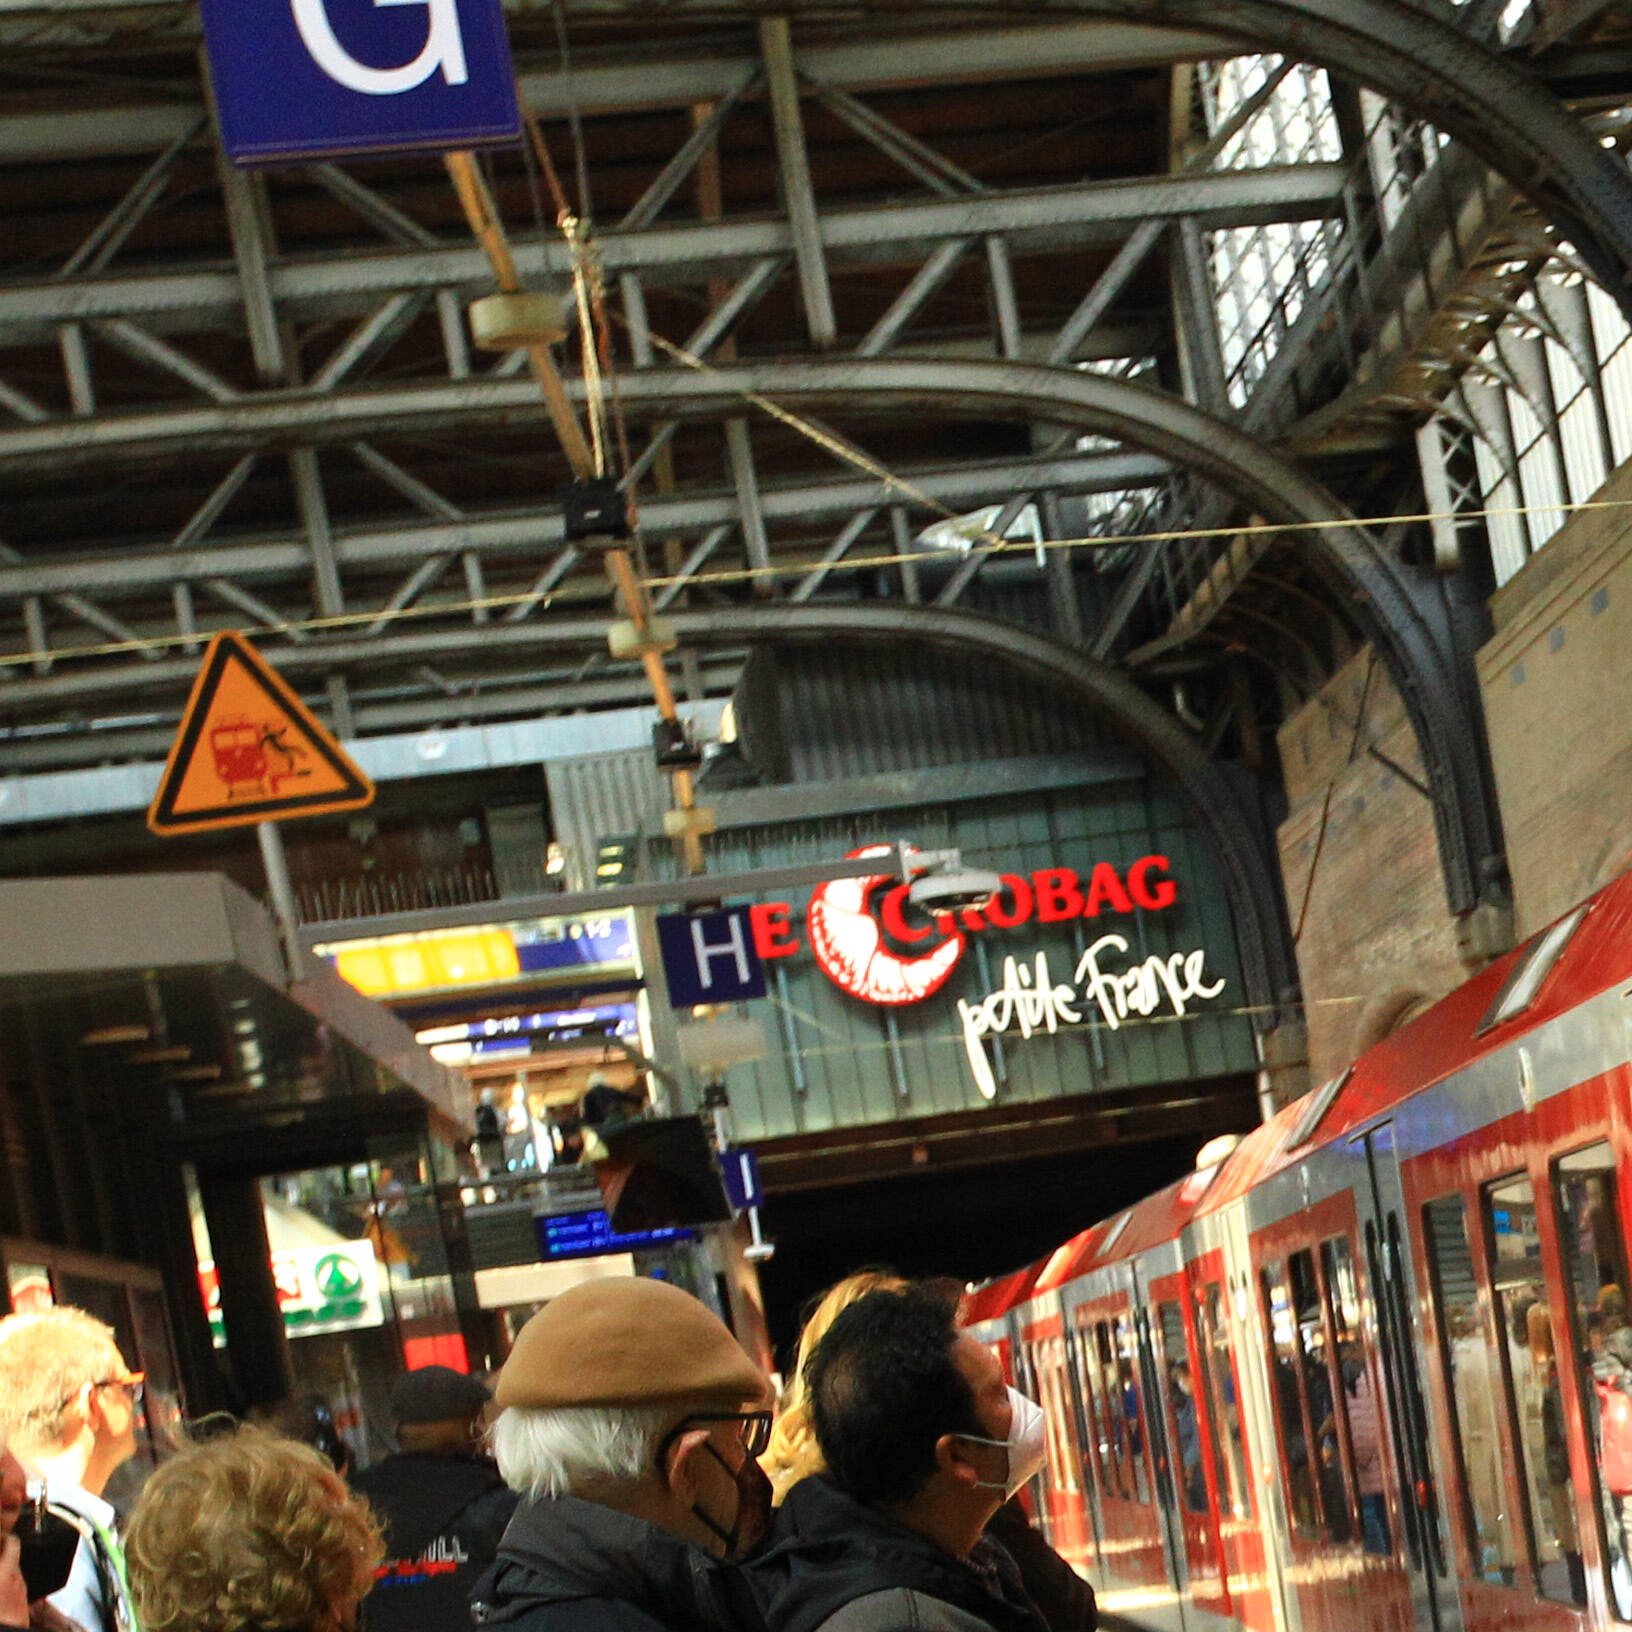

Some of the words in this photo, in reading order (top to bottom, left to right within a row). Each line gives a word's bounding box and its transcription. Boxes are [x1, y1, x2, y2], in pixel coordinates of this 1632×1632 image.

[690, 913, 751, 990] H
[750, 902, 799, 960] E
[1074, 934, 1226, 1031] France
